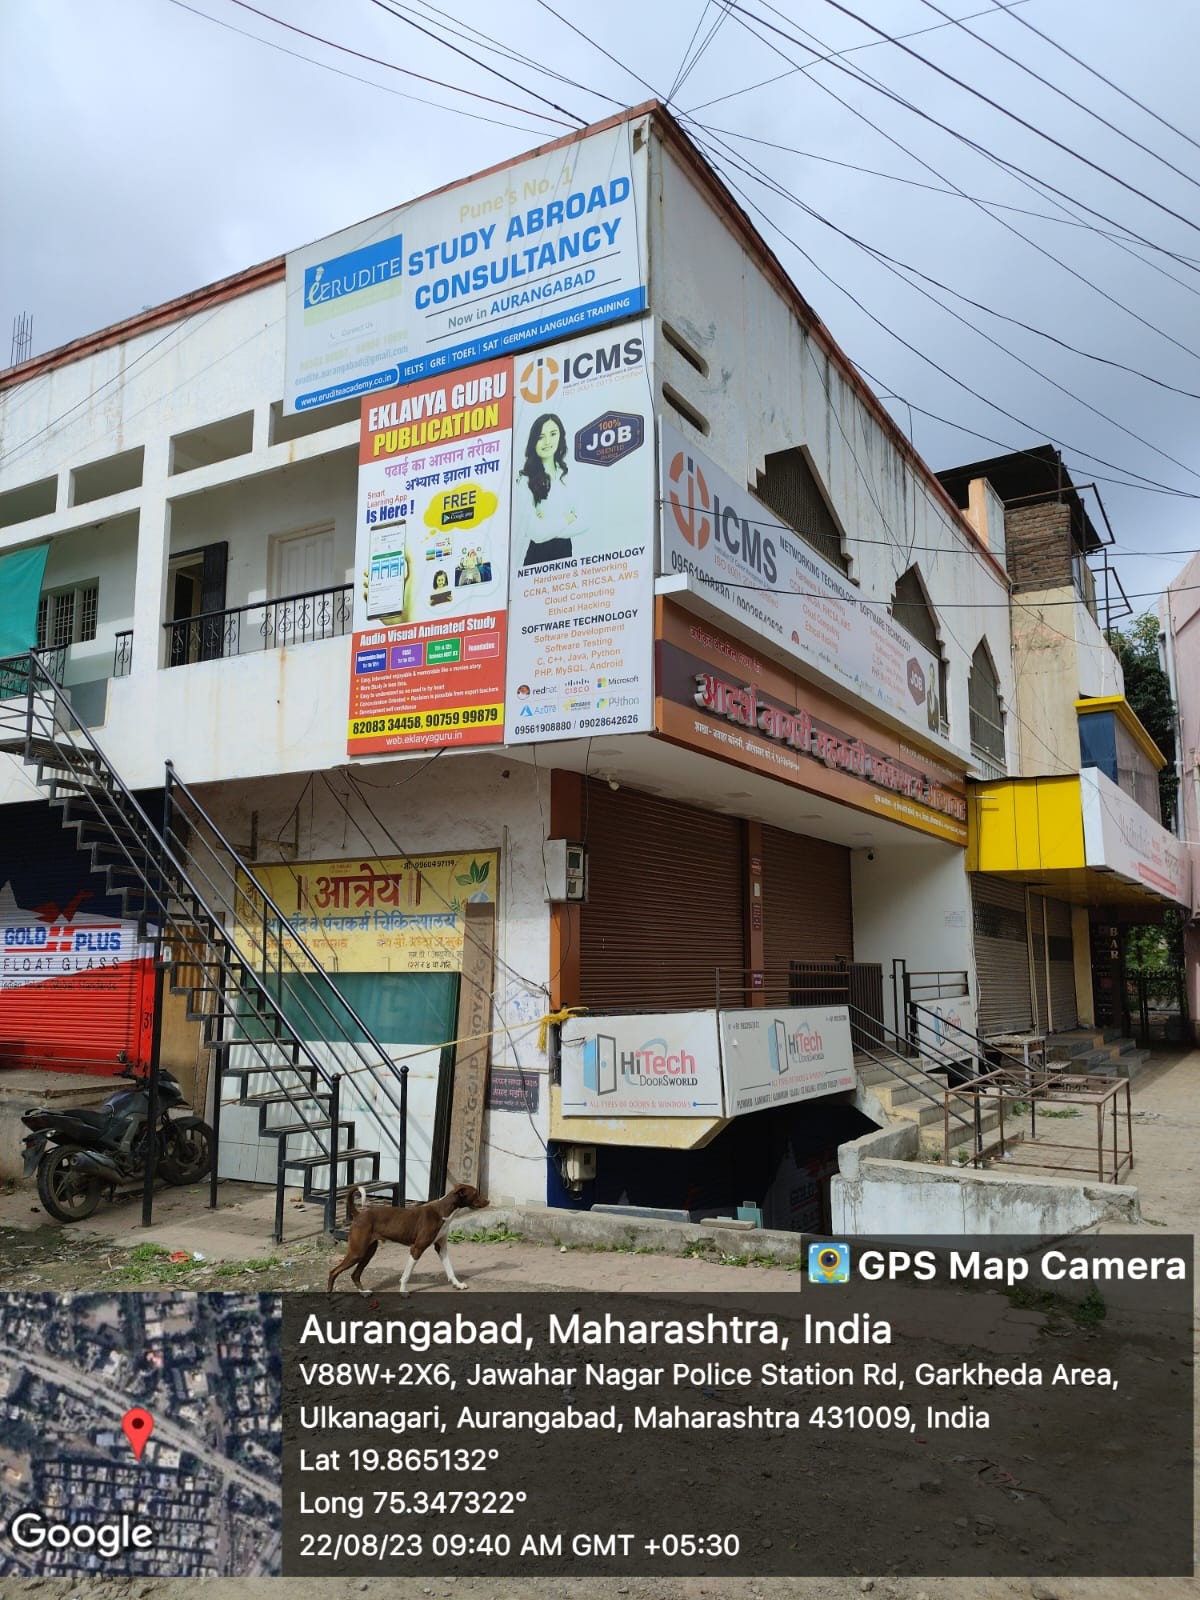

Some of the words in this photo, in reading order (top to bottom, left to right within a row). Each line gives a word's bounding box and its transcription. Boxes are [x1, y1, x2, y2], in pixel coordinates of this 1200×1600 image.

[522, 175, 554, 200] No.
[408, 224, 496, 277] STUDY
[506, 176, 631, 242] ABROAD
[414, 216, 622, 310] CONSULTANCY
[448, 310, 473, 329] Now
[476, 307, 488, 320] in
[490, 269, 596, 315] AURANGABAD
[404, 362, 424, 377] IELTS
[430, 356, 447, 369] GRE
[452, 347, 476, 362] TOEFL
[483, 339, 499, 352] SAT
[503, 326, 538, 345] GERMAN
[539, 310, 585, 335] LANGUAGE
[585, 296, 631, 320] TRAINING
[563, 337, 644, 384] ICMS
[368, 387, 447, 433] EKLAVYA
[451, 371, 508, 411] GURU
[373, 403, 500, 458] PUBLICATION
[597, 418, 622, 431] 100%
[586, 424, 632, 452] JOB
[411, 459, 425, 472] का
[429, 448, 464, 469] आसान
[466, 438, 501, 460] तरीका
[405, 473, 439, 492] अभ्यास
[442, 466, 471, 484] झाला
[473, 457, 500, 476] सोपा
[443, 490, 477, 510] FREE
[366, 509, 377, 524] Is
[379, 503, 408, 521] Here
[713, 494, 777, 584] ICMS
[518, 559, 578, 579] NETWORKING
[580, 546, 646, 566] TECHNOLOGY
[780, 535, 820, 580] NETWORKING
[533, 571, 571, 585] Hardware
[572, 568, 579, 578] &
[581, 561, 628, 577] Networking
[618, 570, 640, 581] AWS
[544, 595, 570, 606] Cloud
[570, 587, 616, 604] Computing
[548, 604, 576, 616] Ethical
[577, 599, 612, 613] Hacking
[360, 631, 386, 647] Audio
[387, 627, 417, 643] Visual
[417, 621, 465, 638] Animated
[466, 615, 496, 632] Study
[521, 619, 571, 635] SOFTWARE
[573, 609, 639, 627] TECHNOLOGY
[534, 631, 569, 644] Software
[571, 623, 626, 639] Development
[545, 640, 581, 653] Software
[583, 637, 613, 650] Testing
[592, 648, 621, 663] Python
[590, 659, 624, 671] Android
[564, 685, 590, 695] CISCO
[608, 676, 640, 686] Microsoft
[909, 673, 923, 693] JOB
[353, 721, 386, 735] 82083
[425, 711, 460, 728] 90759
[462, 707, 498, 724] 99879
[534, 704, 557, 715] Azure
[514, 720, 572, 736] 09561908880
[579, 713, 639, 730] 09028642626
[693, 673, 760, 730] आदर्श
[758, 701, 813, 754] नागरी
[811, 727, 867, 776] सहकारी
[385, 730, 463, 747] web.eklavyaguru.in
[314, 863, 402, 910] आत्रेय
[322, 910, 371, 932] पंचकर्म
[4, 926, 47, 946] GOLD
[75, 931, 121, 952] PLUS
[1110, 927, 1119, 961] BAR
[3, 957, 54, 971] FLOAT
[62, 956, 120, 971] GLASS
[788, 1031, 823, 1056] HiTech
[620, 1049, 696, 1075] HiTech
[465, 1056, 481, 1112] GOLD
[462, 1115, 478, 1184] ROYAL
